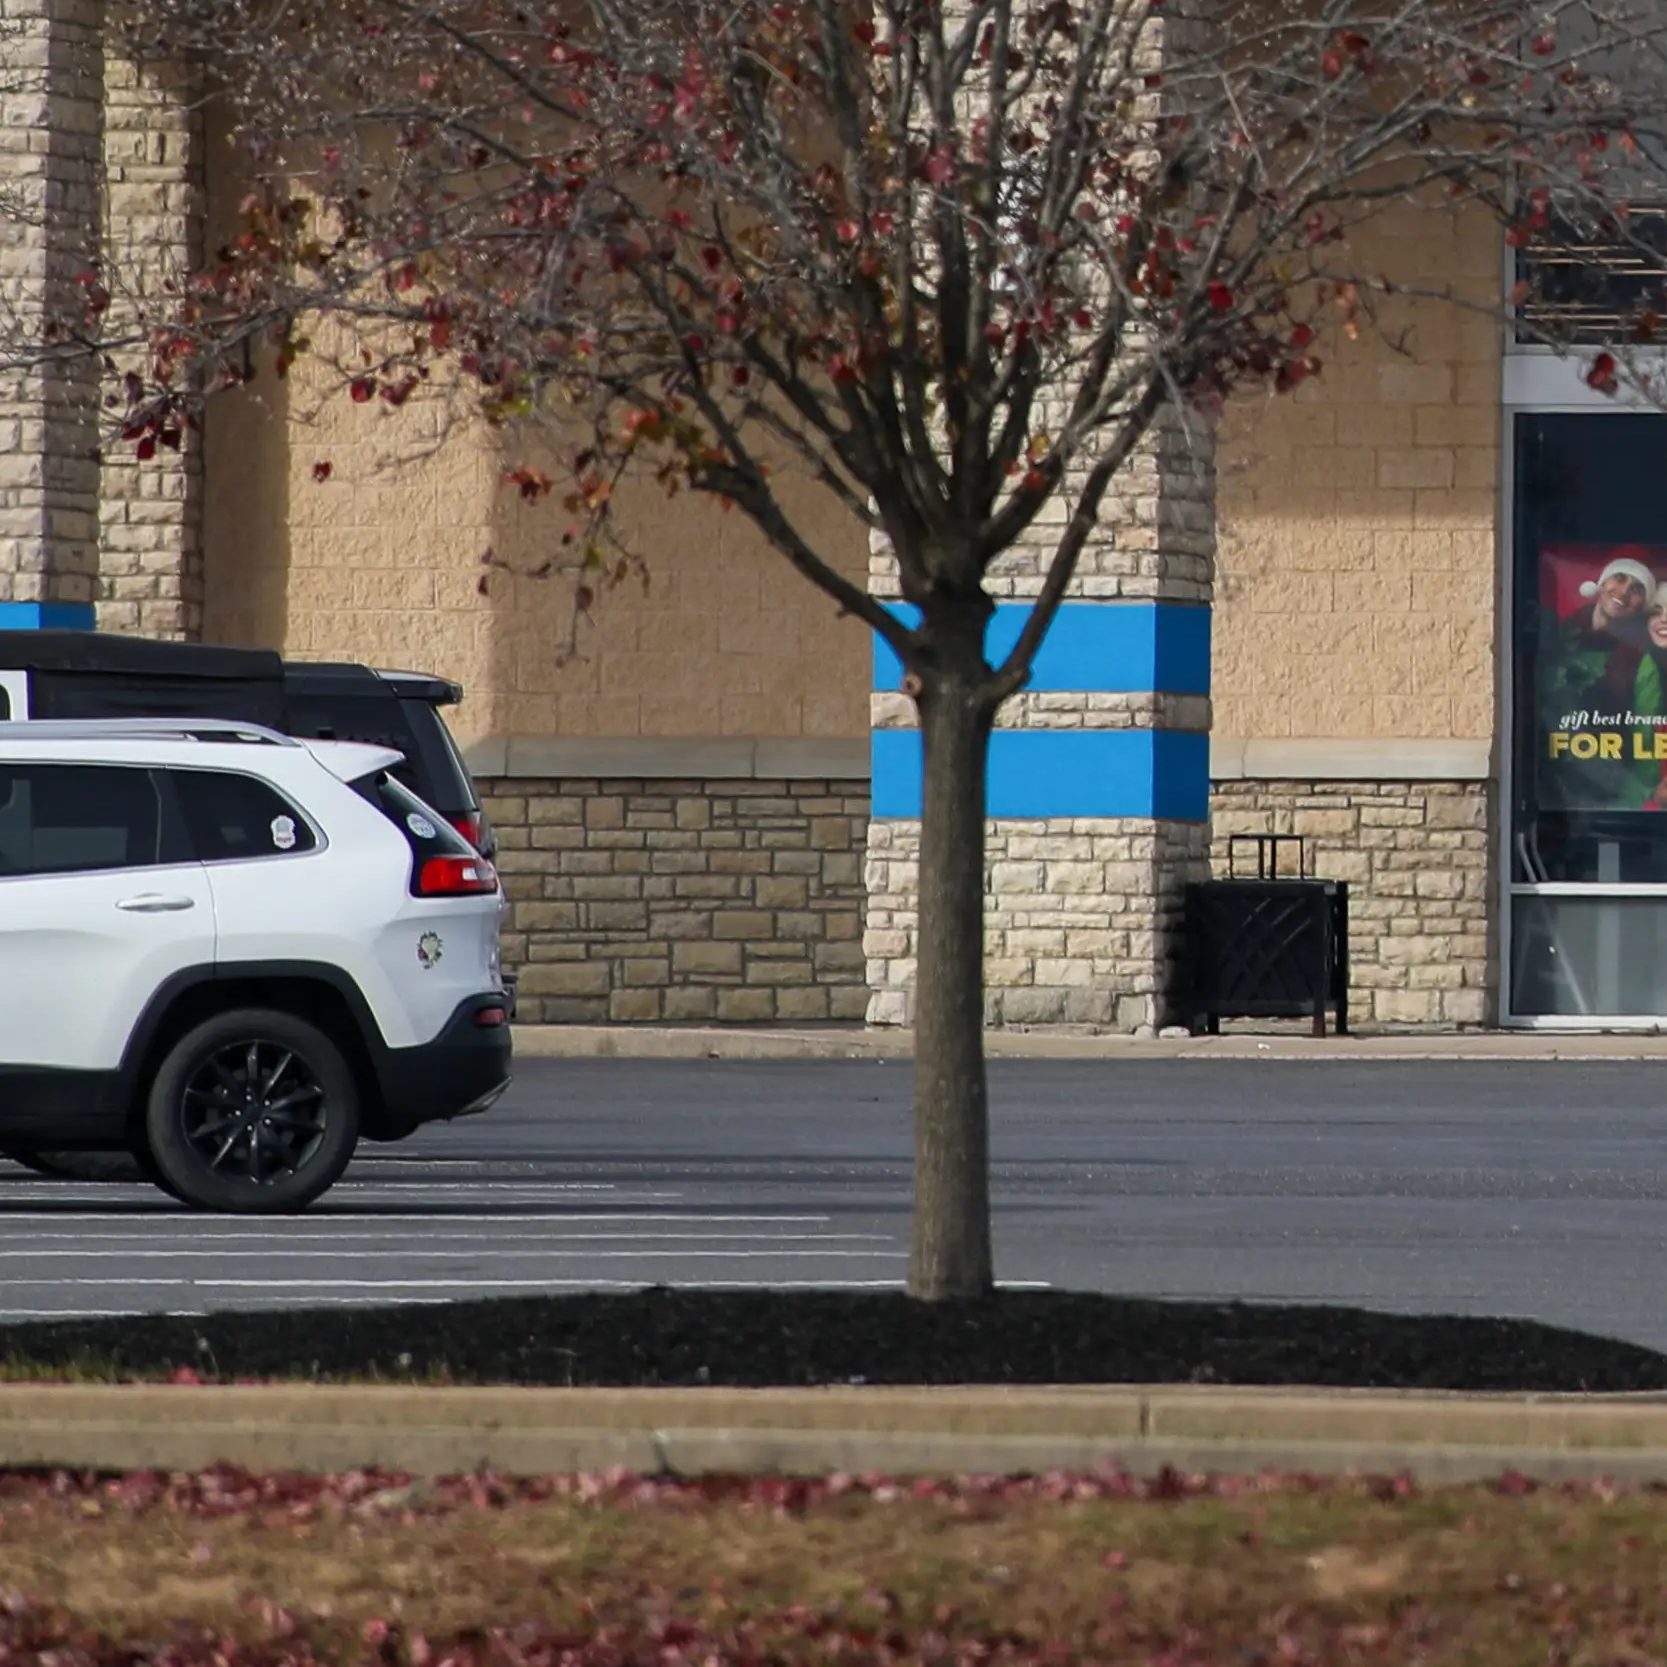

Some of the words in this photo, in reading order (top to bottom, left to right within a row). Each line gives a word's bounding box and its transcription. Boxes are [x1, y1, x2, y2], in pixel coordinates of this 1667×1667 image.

[1558, 710, 1590, 730] gift
[1592, 710, 1621, 726] best
[1549, 732, 1624, 760] FOR
